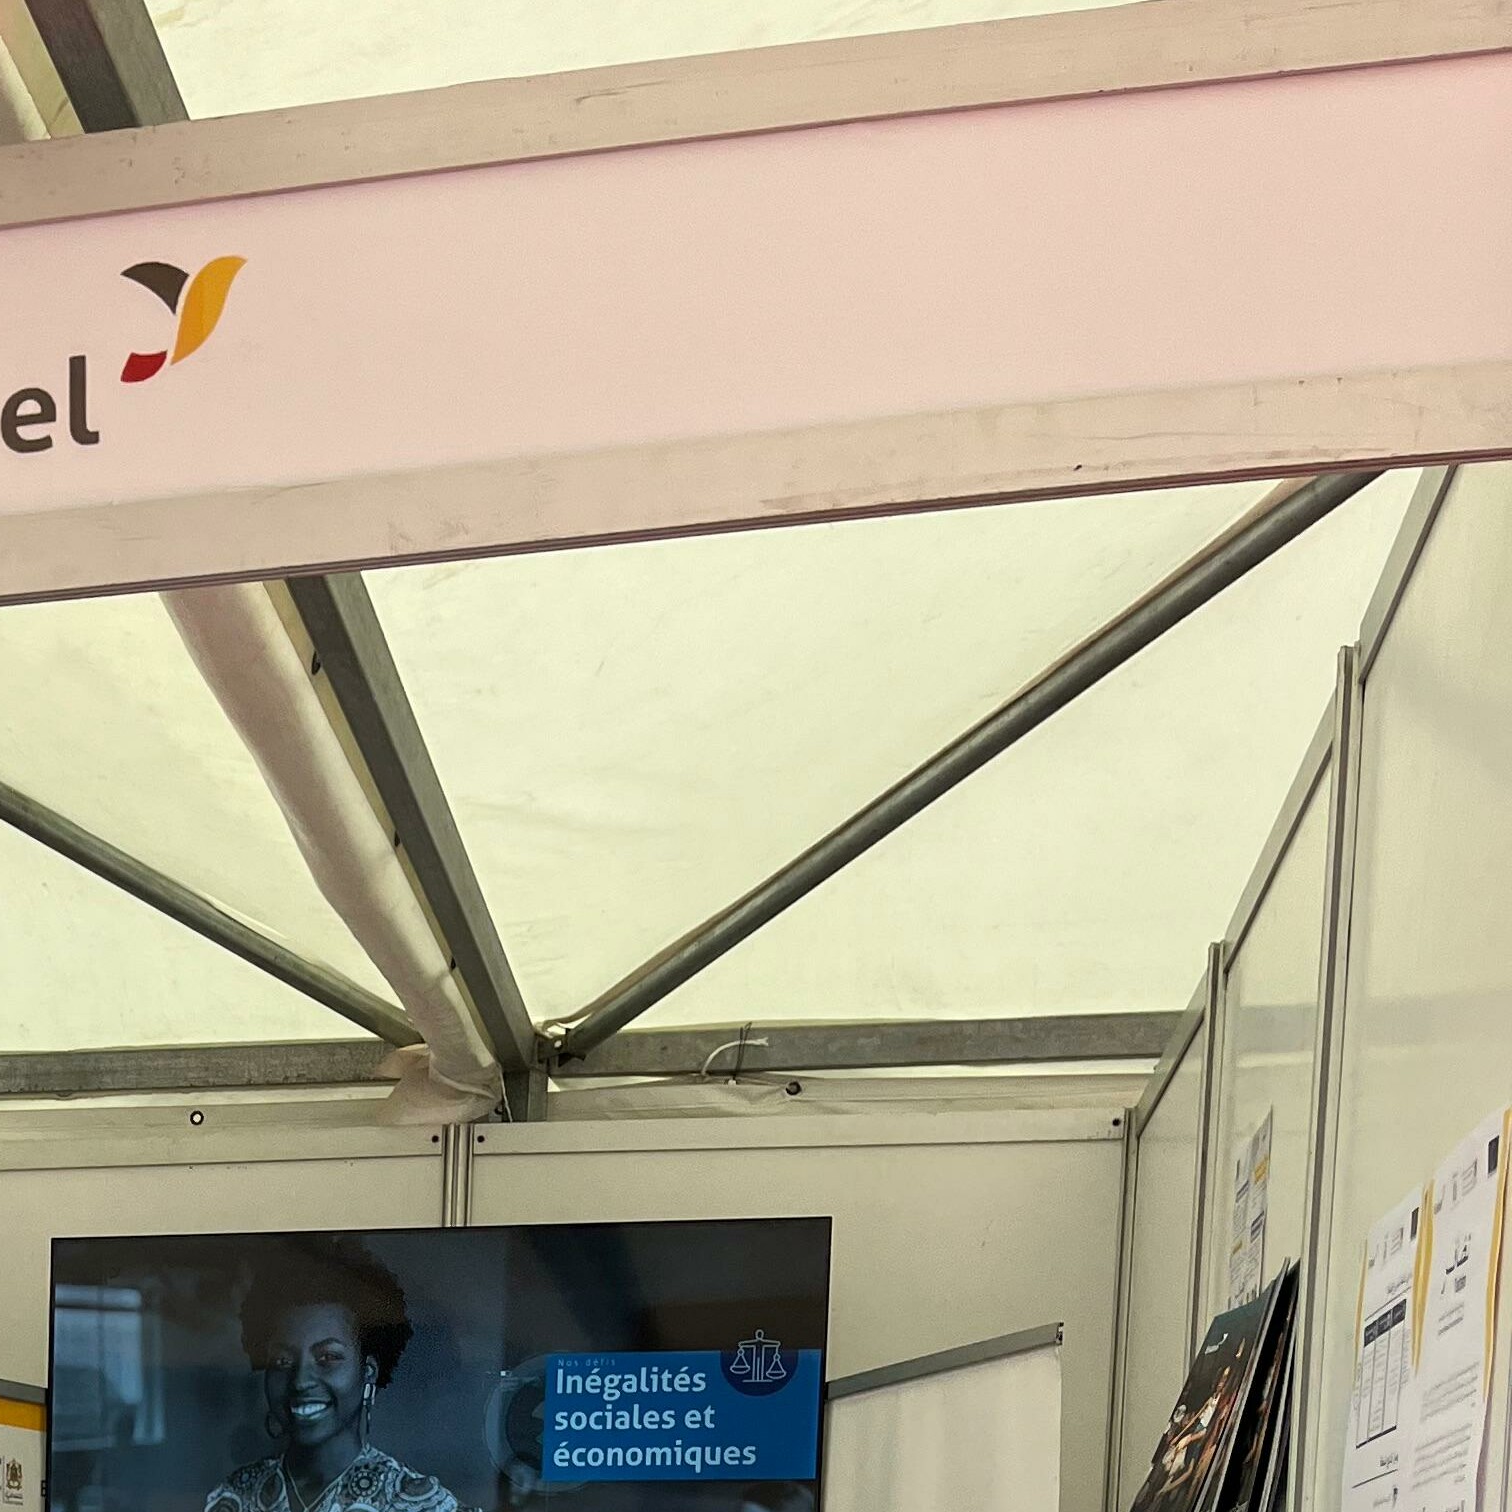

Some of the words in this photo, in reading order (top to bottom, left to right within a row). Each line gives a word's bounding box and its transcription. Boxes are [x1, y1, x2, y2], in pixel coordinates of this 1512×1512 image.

[556, 1366, 707, 1401] Inégalités
[554, 1404, 676, 1431] sociales
[684, 1405, 716, 1429] et
[553, 1440, 757, 1473] économiques
